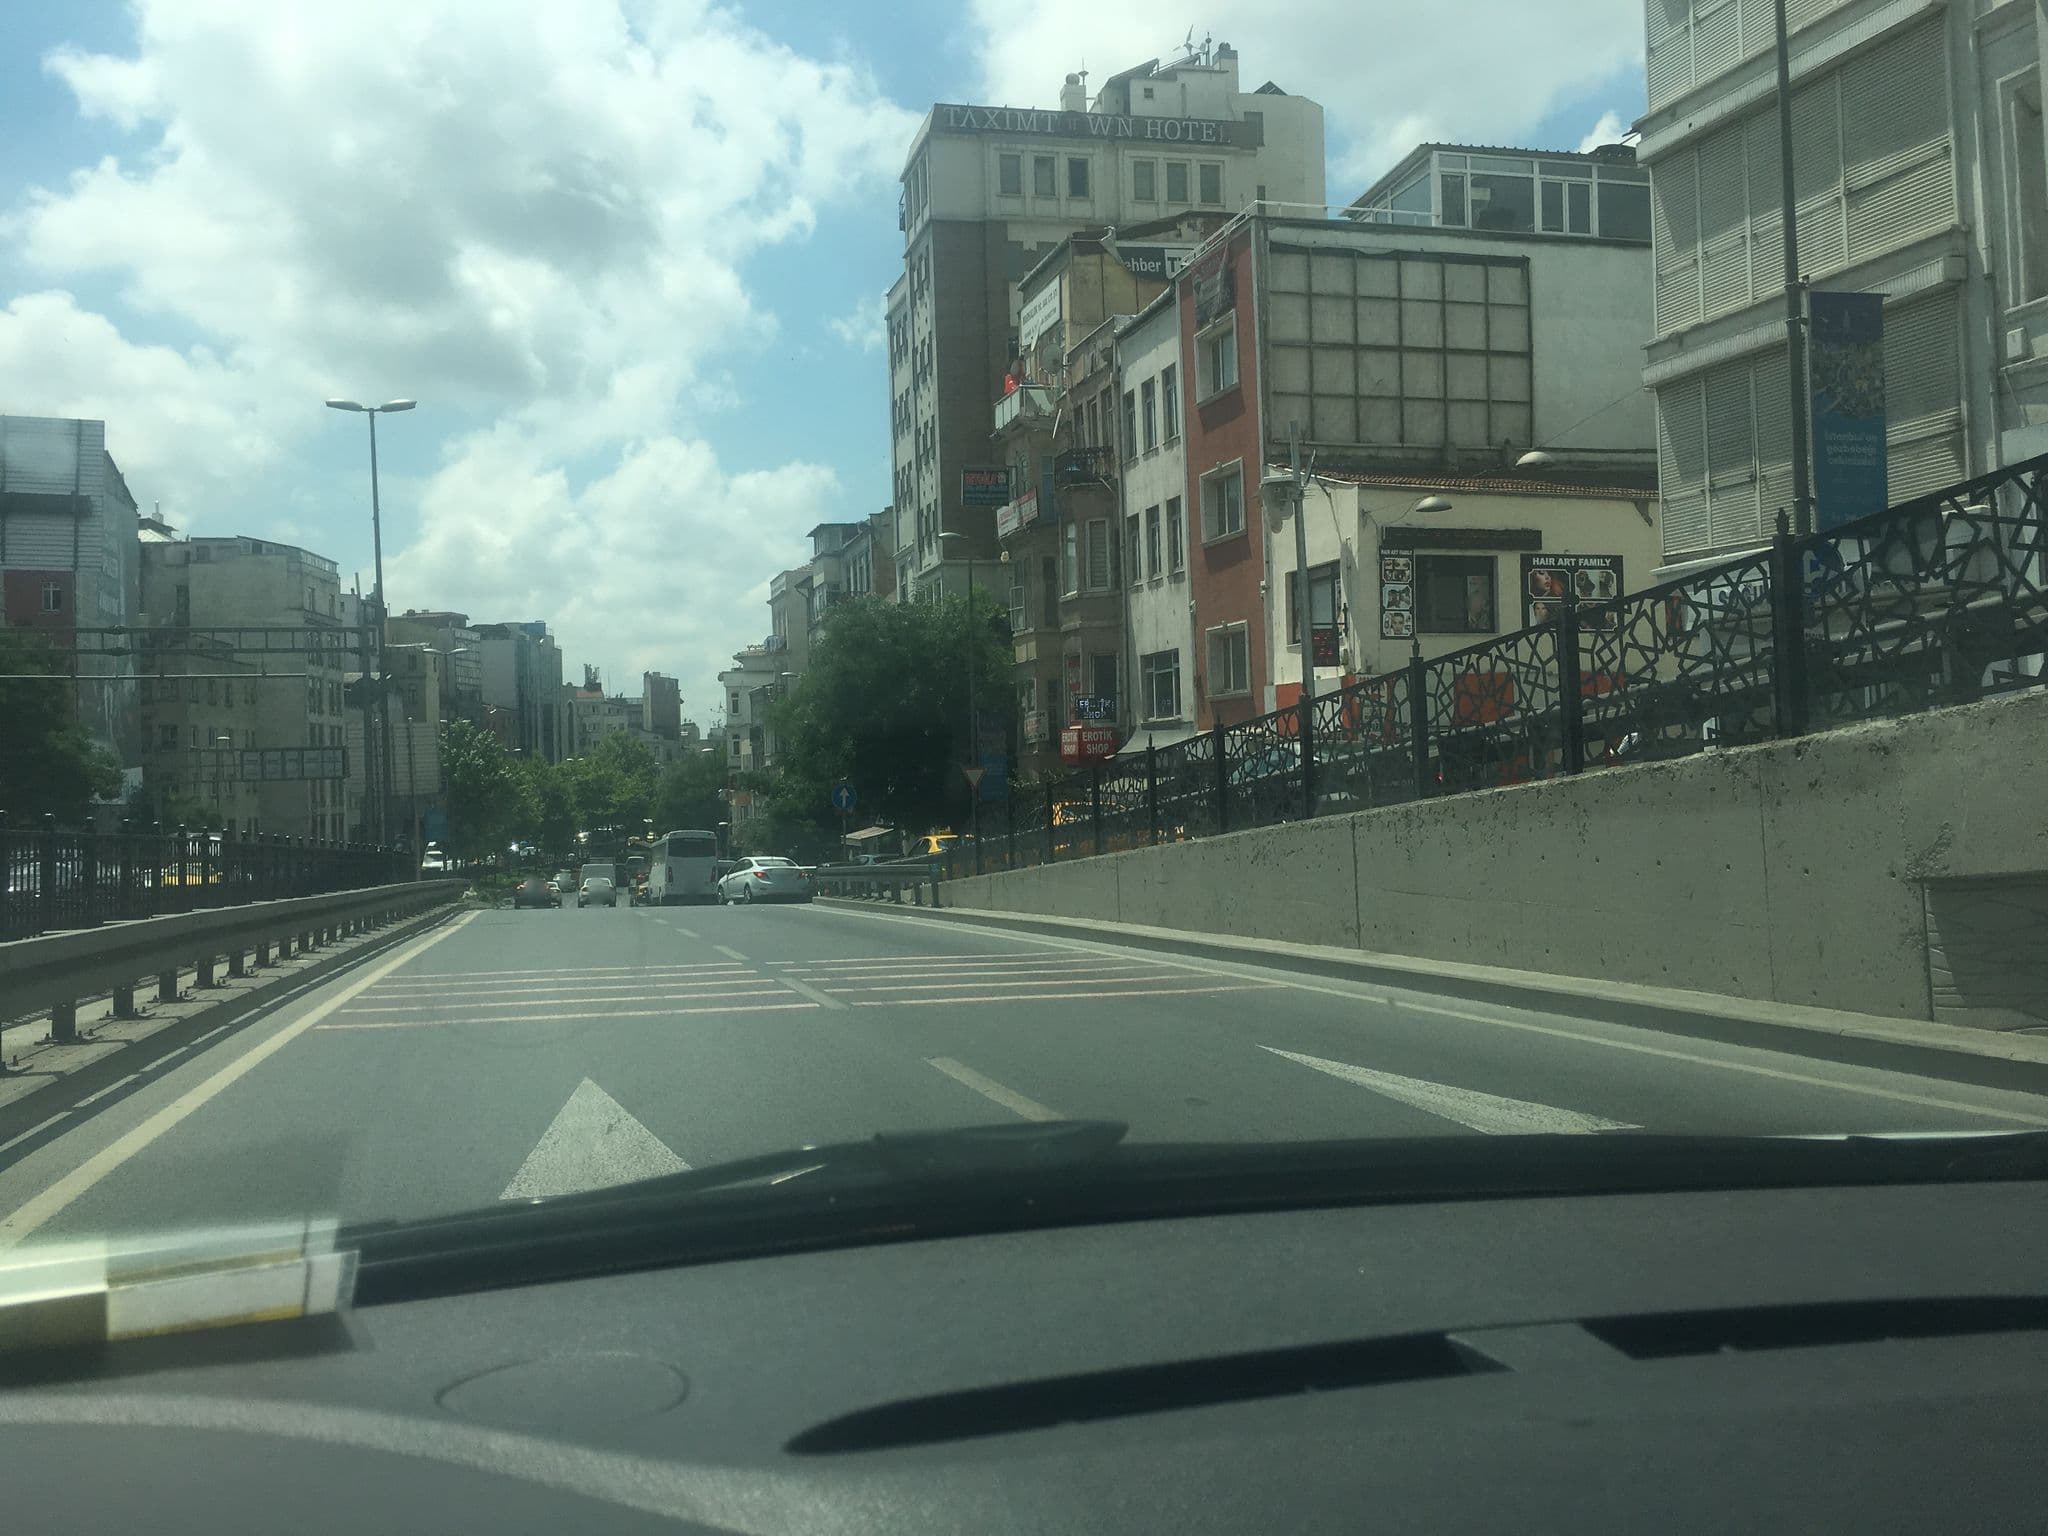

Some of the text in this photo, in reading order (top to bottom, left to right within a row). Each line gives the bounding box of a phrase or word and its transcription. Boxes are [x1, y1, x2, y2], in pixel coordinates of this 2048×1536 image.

[1145, 120, 1230, 143] HOTEL
[1532, 557, 1611, 567] HAIR ART FAMILY
[1087, 744, 1109, 754] SHOP
